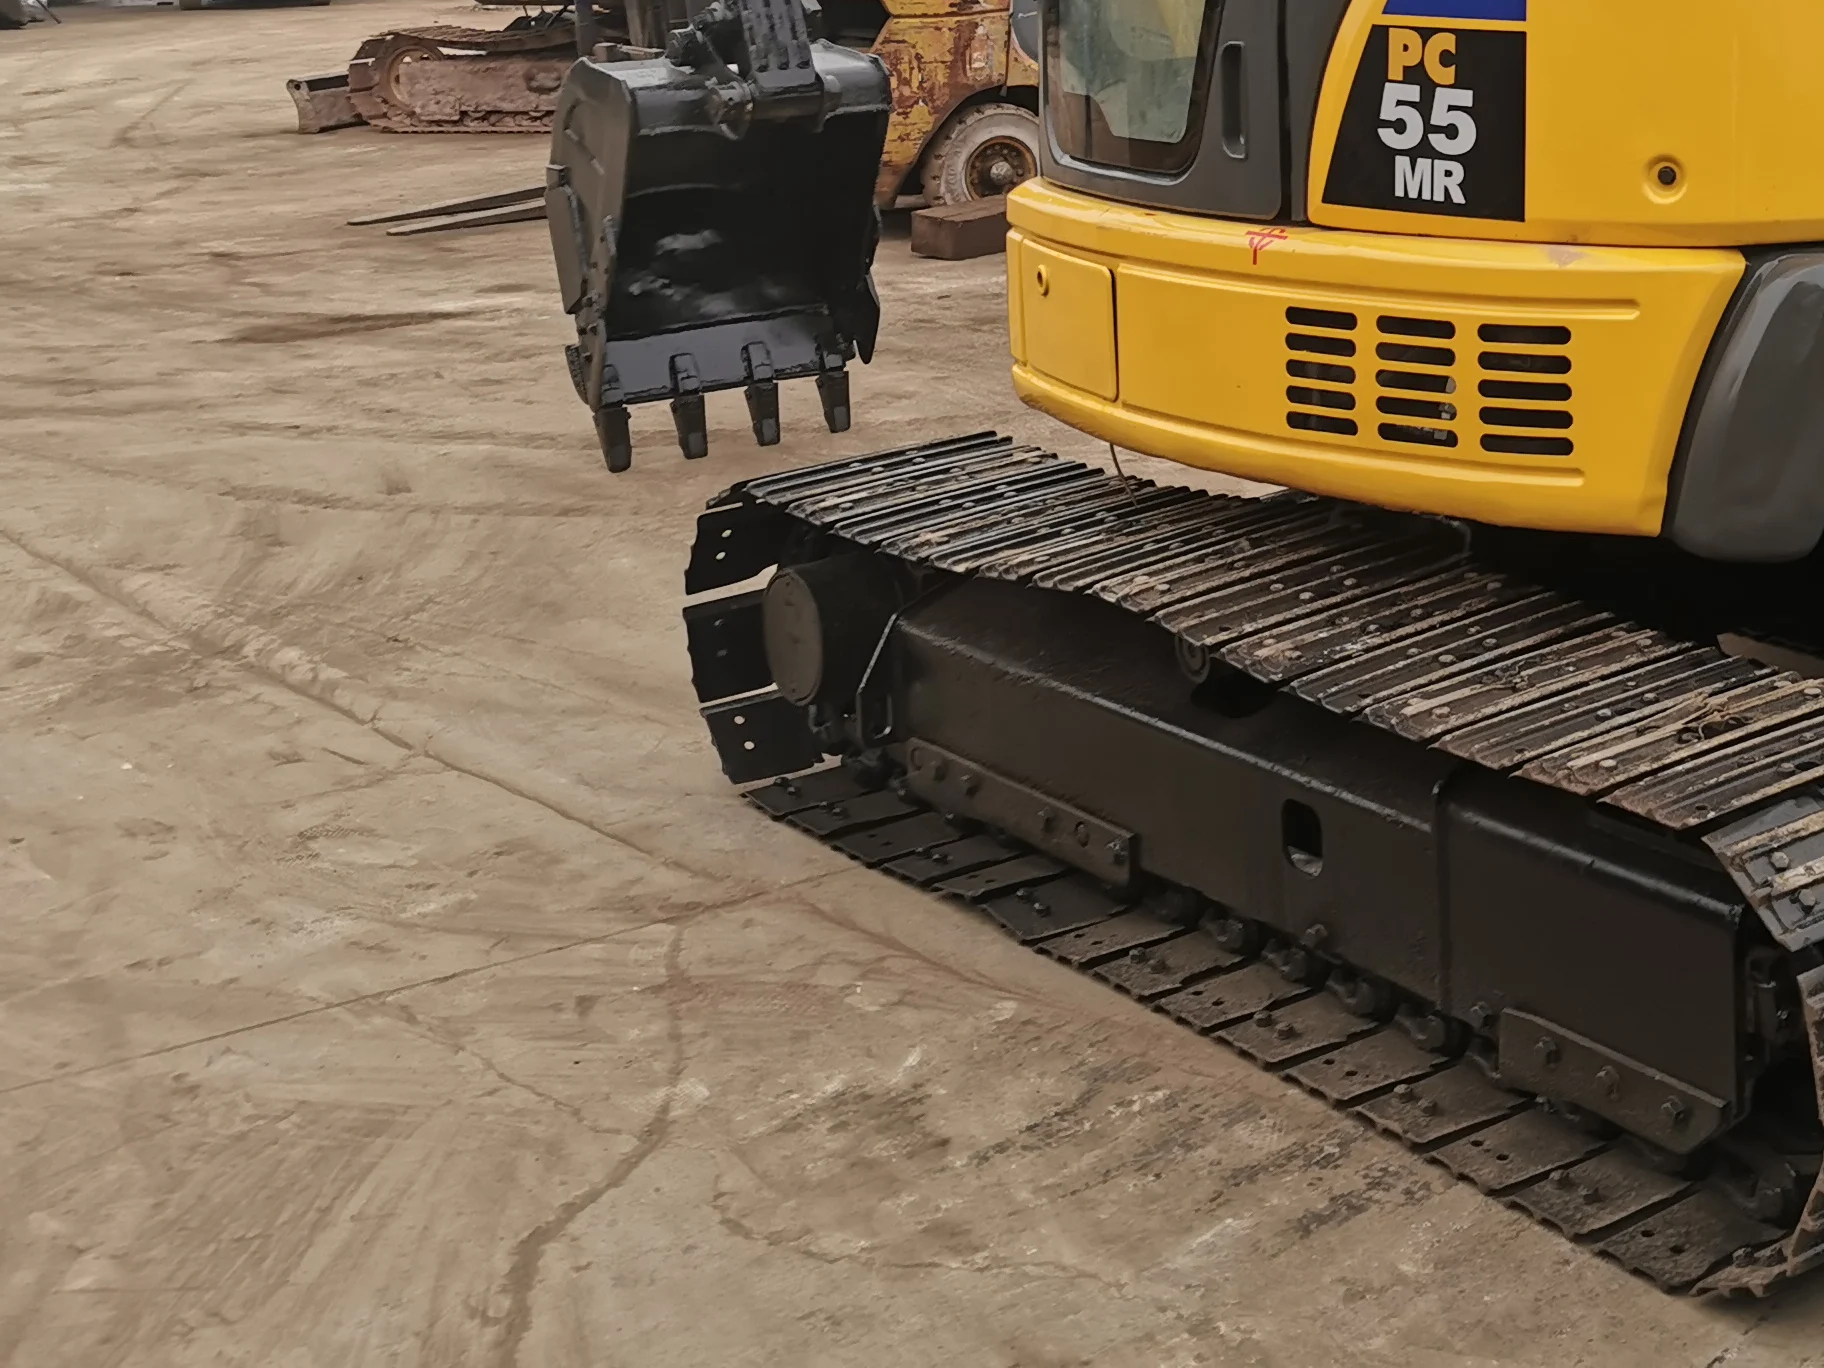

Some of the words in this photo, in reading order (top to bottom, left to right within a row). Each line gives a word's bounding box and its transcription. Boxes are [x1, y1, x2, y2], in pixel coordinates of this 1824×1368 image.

[1387, 27, 1457, 86] PC
[1377, 82, 1477, 156] 55
[1394, 155, 1466, 205] MR
